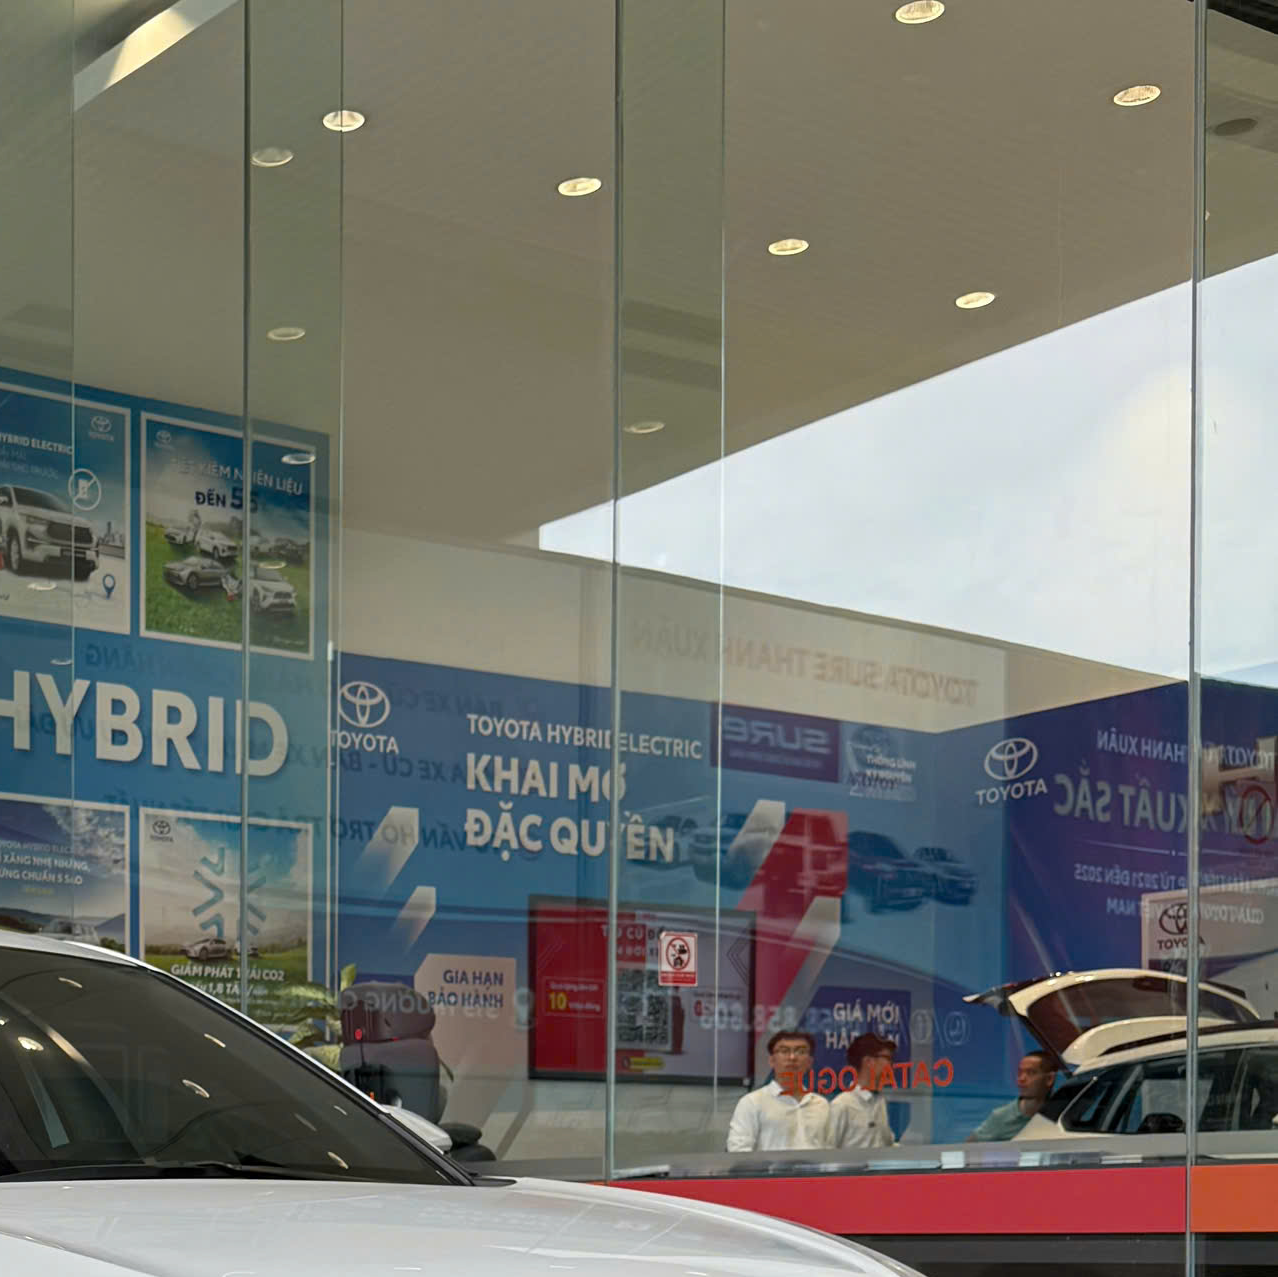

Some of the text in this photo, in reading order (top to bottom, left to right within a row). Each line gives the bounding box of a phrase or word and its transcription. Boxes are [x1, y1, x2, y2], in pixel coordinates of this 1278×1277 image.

[466, 713, 543, 742] TOYOTA
[330, 729, 399, 755] TOYOTA
[466, 752, 559, 798] KHAI
[975, 778, 1048, 806] TOYOTA
[464, 800, 544, 862] ĐẶC
[443, 969, 468, 985] GIA
[833, 998, 862, 1022] GIÁ
